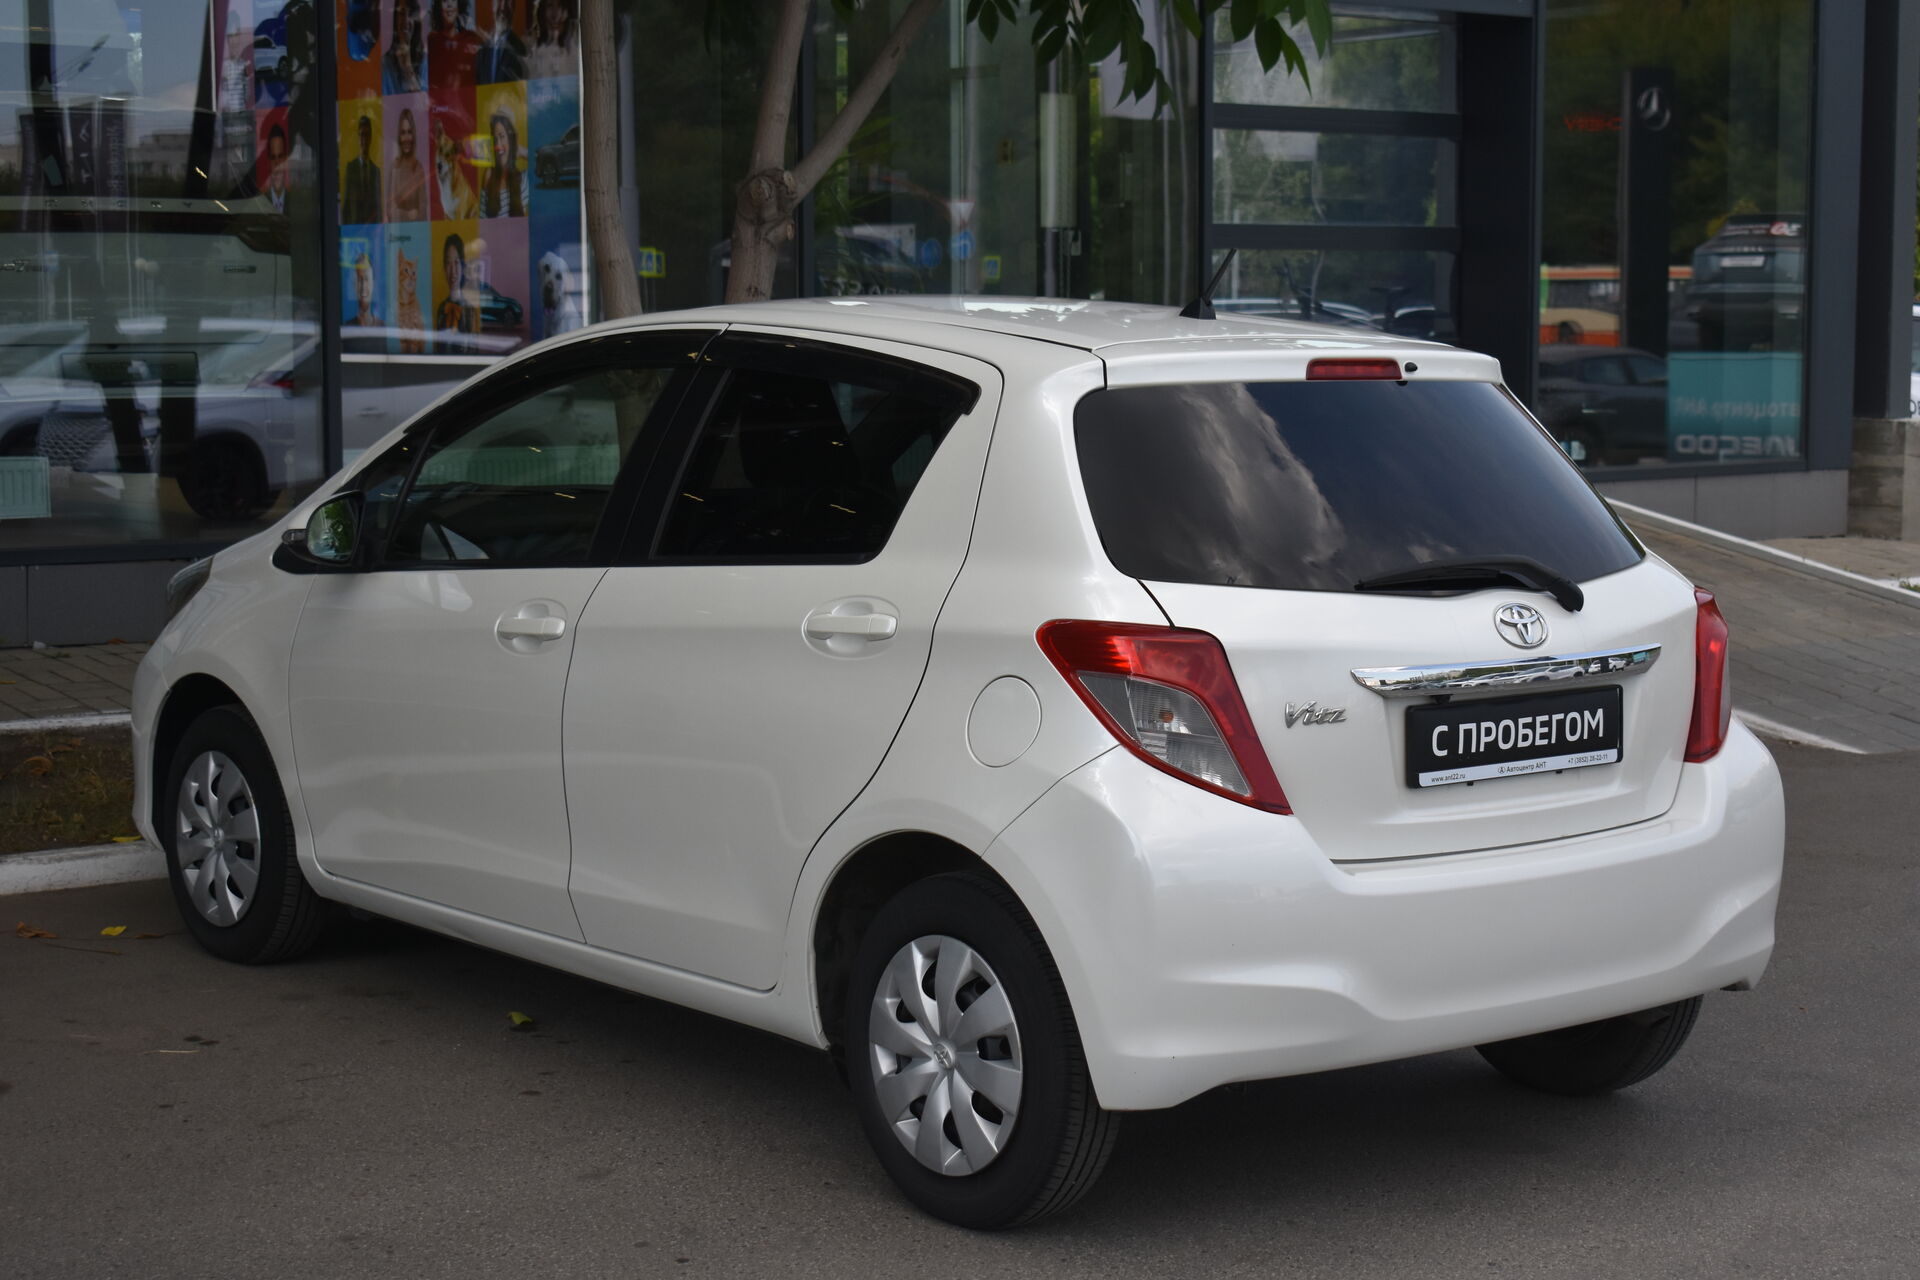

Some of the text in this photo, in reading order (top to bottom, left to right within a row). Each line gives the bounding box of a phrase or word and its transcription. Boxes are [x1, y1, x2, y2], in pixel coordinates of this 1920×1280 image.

[1284, 700, 1347, 729] Vitz
[1432, 708, 1604, 757] С ПРОБЕГОМ
[1506, 761, 1547, 773] Автоцентр АНТ
